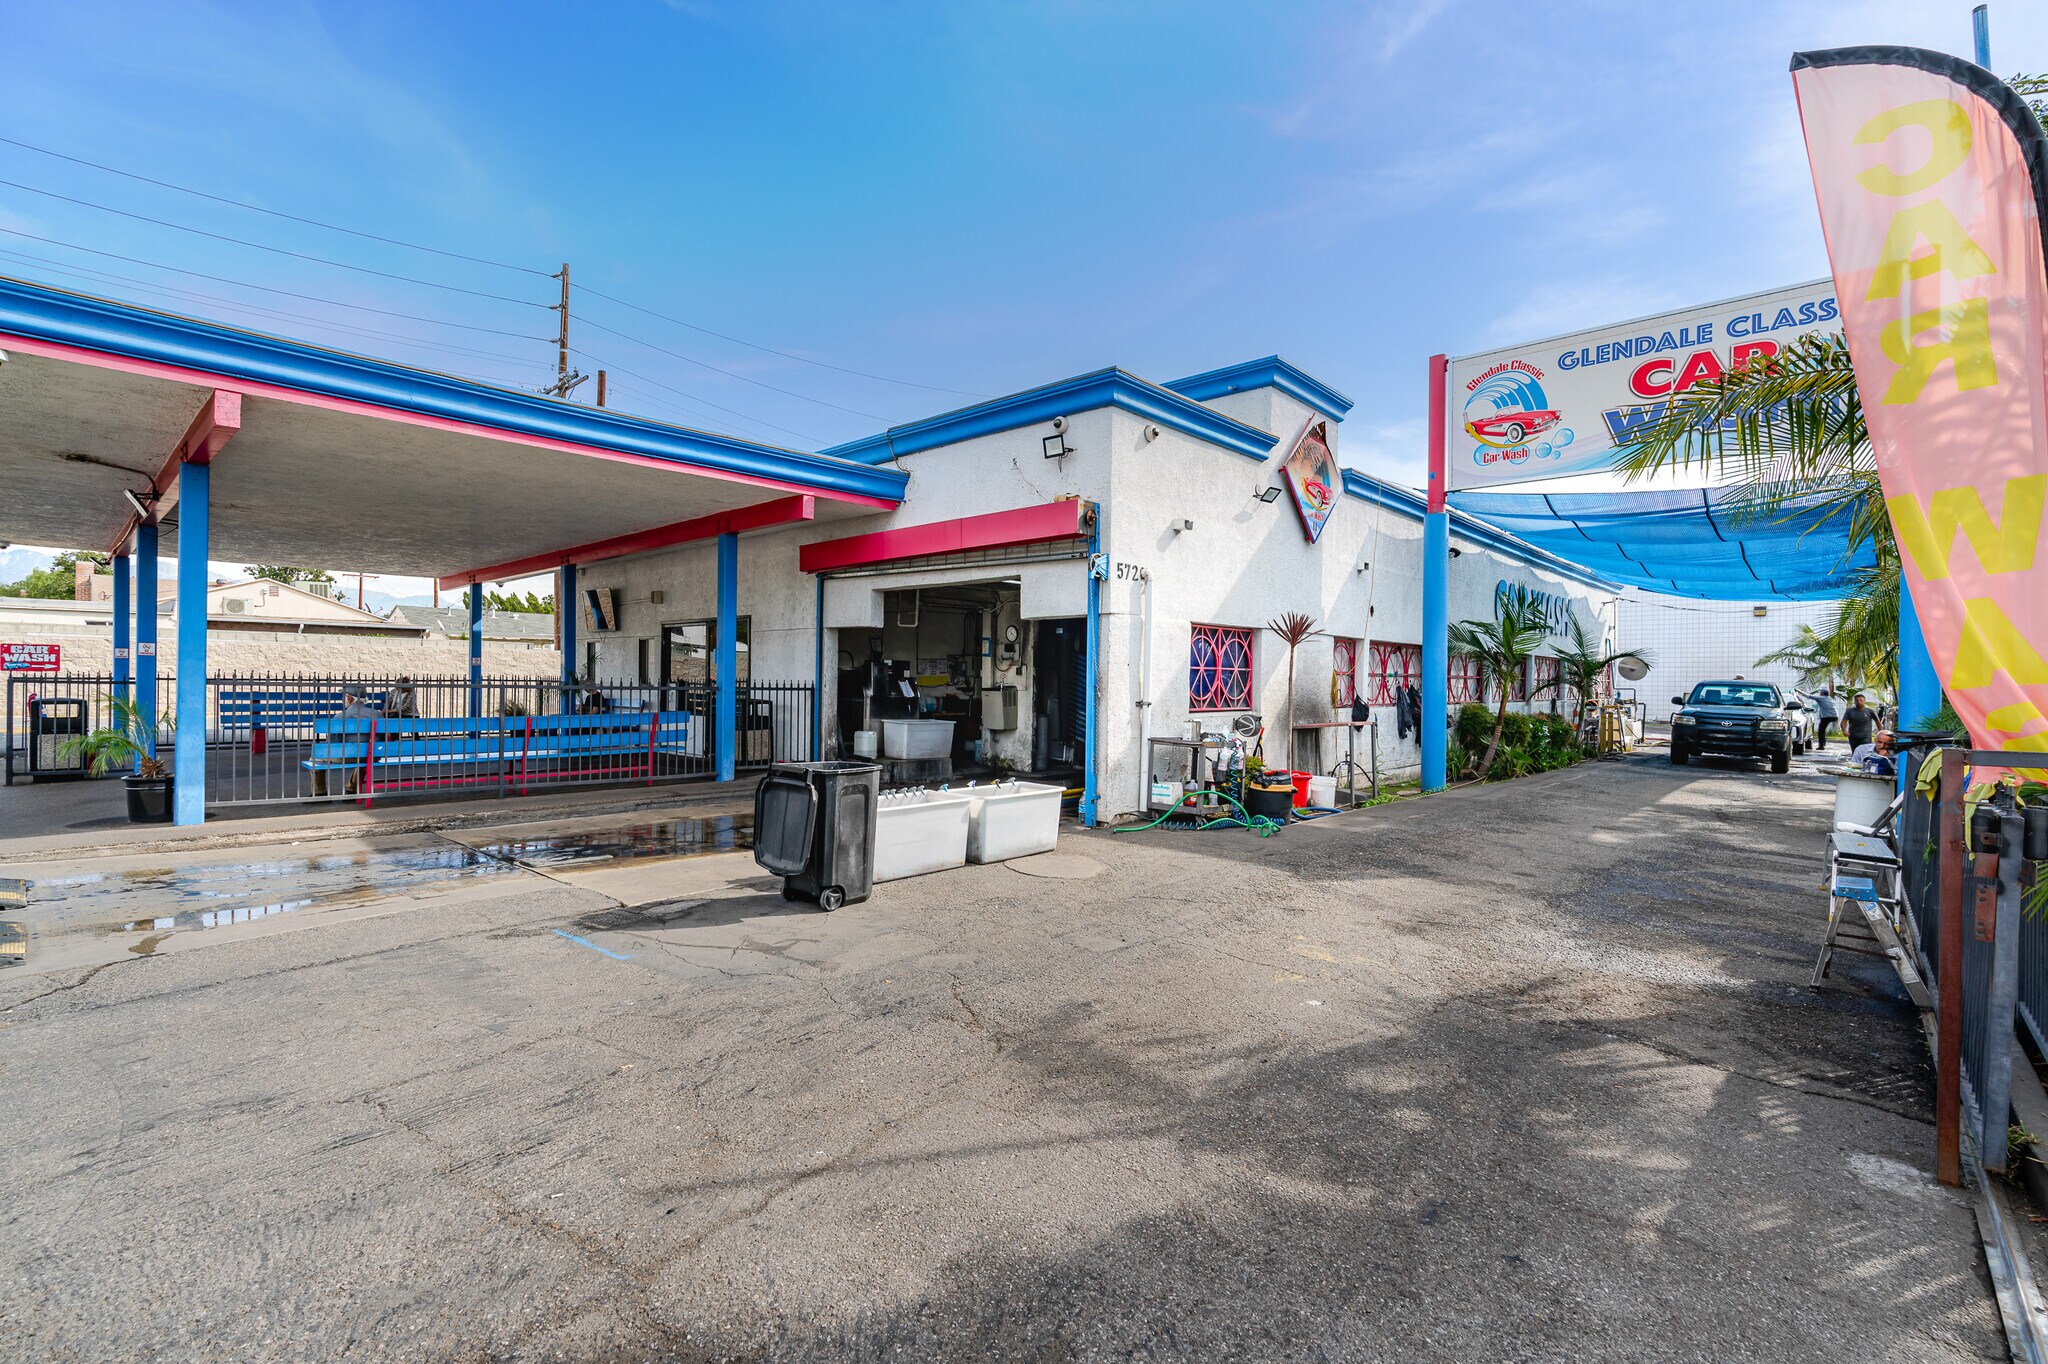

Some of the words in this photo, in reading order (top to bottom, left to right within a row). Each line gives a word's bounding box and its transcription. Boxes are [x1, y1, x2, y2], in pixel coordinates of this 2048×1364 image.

[1557, 323, 1713, 371] GLENDALE
[1726, 298, 1842, 340] CLASS
[1466, 363, 1509, 392] Glendale
[1510, 360, 1545, 381] Classic
[1629, 339, 1784, 398] CAR
[1483, 452, 1500, 464] Car
[1502, 447, 1528, 461] Wash
[2, 653, 57, 662] WASH
[10, 645, 49, 654] CAR
